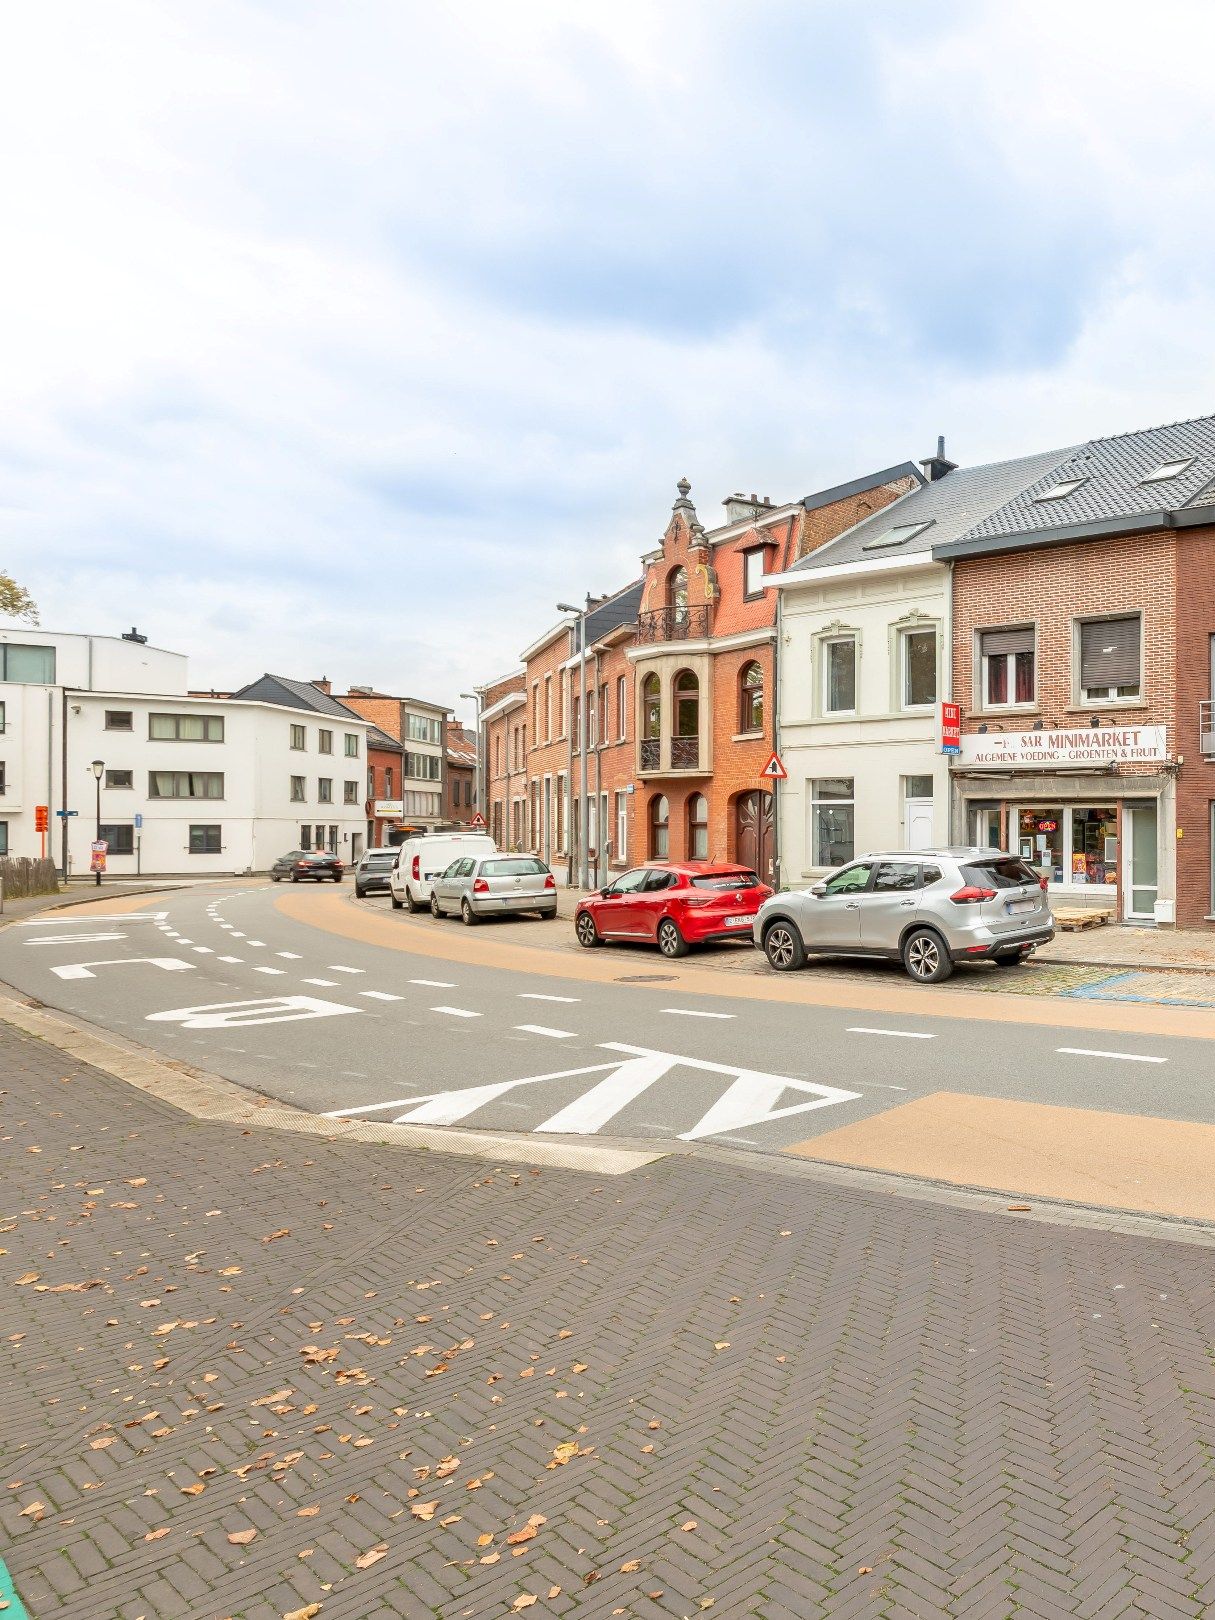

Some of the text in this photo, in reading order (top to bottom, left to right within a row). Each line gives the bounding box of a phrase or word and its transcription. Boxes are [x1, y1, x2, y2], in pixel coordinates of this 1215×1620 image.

[1021, 735, 1043, 748] SAR
[1048, 731, 1141, 749] MINIMARKET
[975, 752, 1018, 762] ALGEMENE
[1020, 750, 1060, 761] VOEDING
[1068, 748, 1118, 760] GROENTEN
[1120, 748, 1128, 758] &
[1131, 747, 1159, 758] FRUIT
[1039, 821, 1056, 831] OPEN
